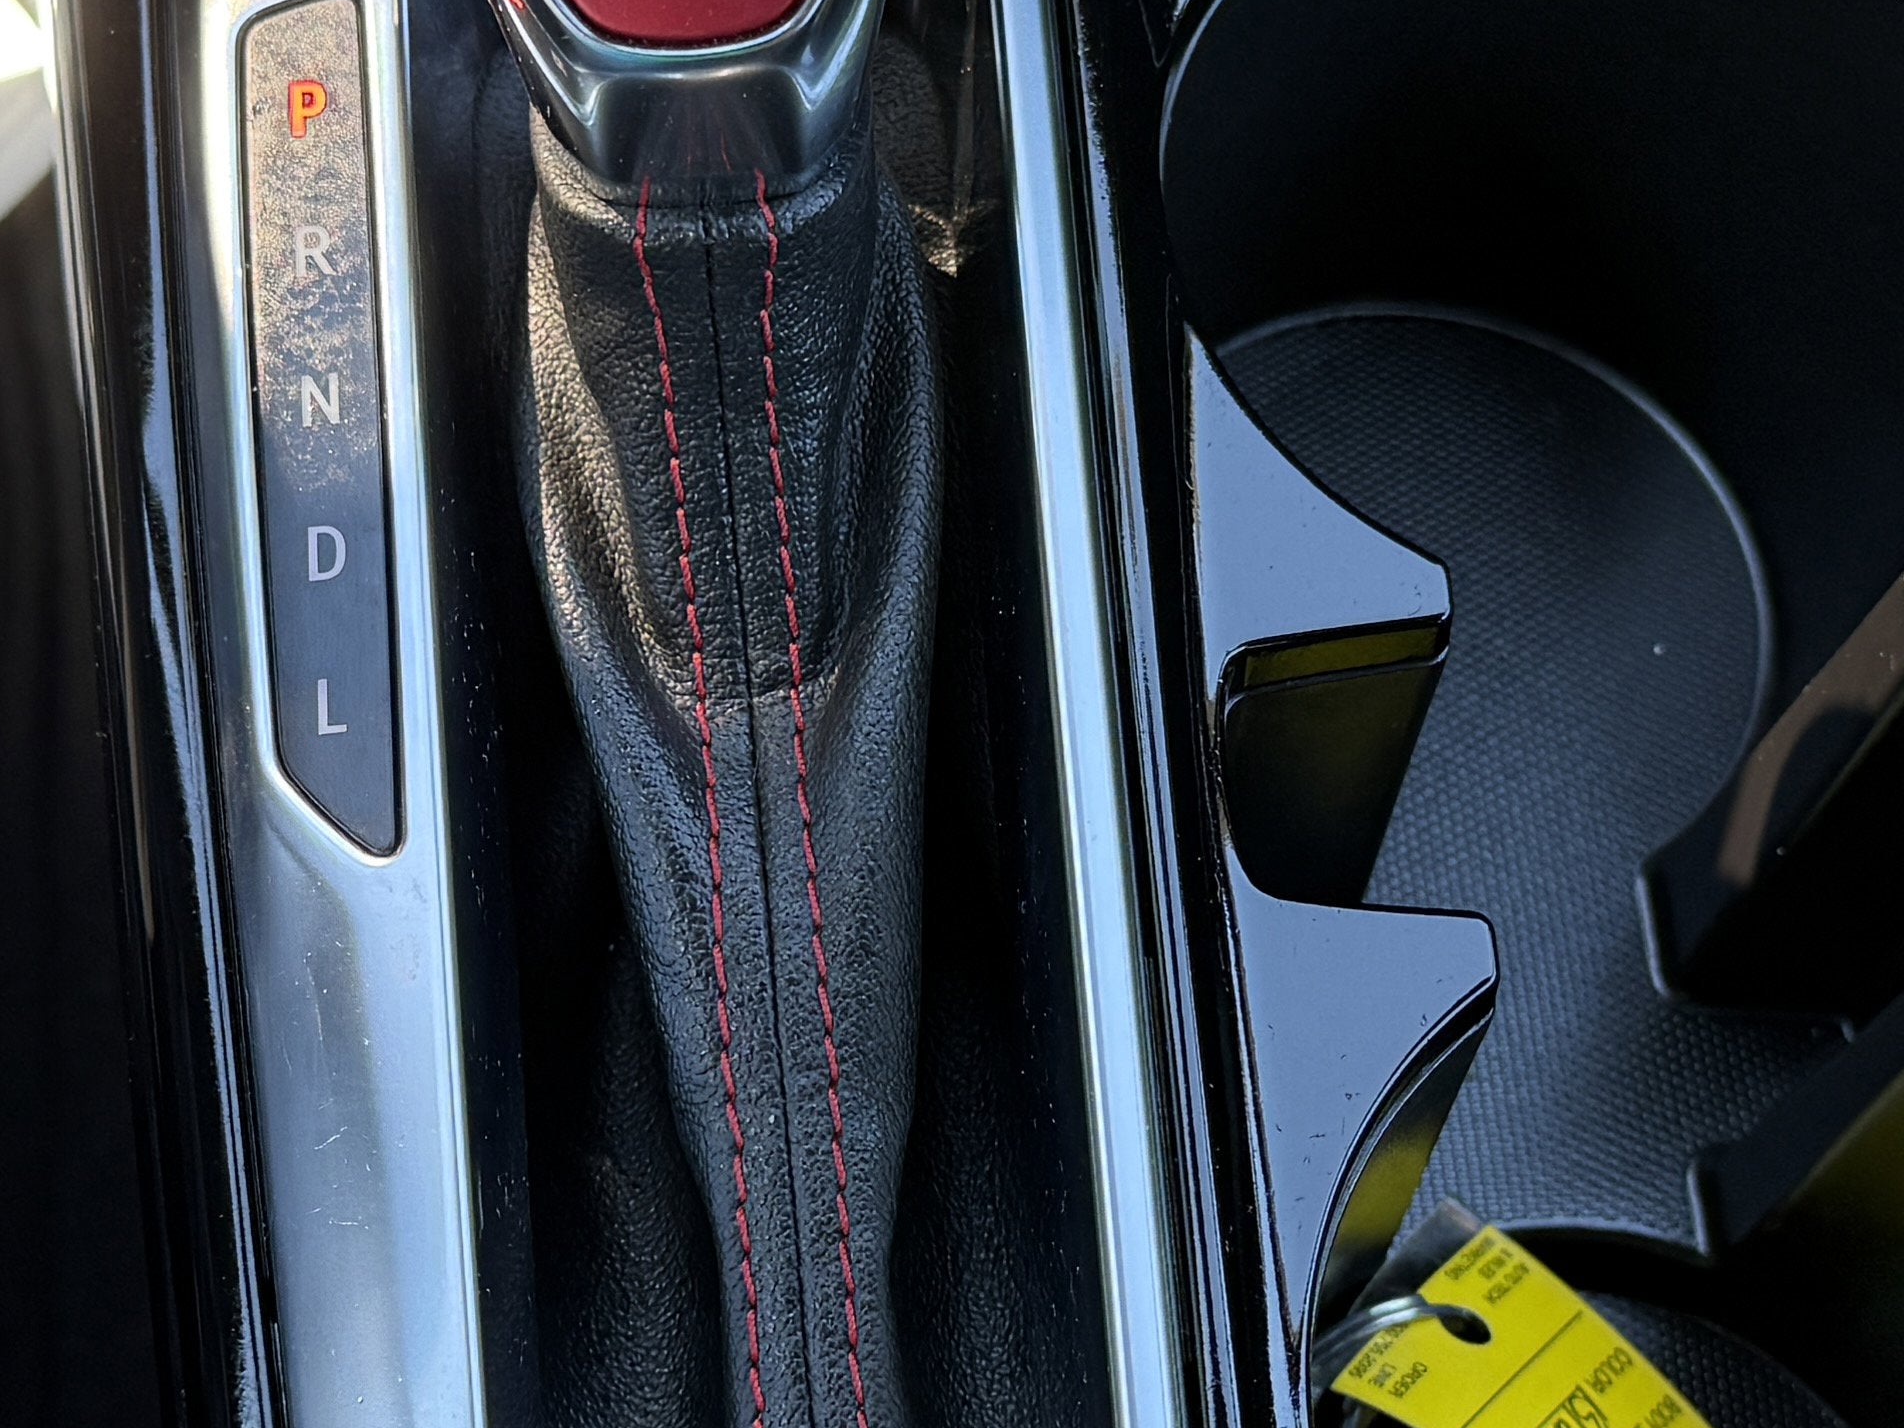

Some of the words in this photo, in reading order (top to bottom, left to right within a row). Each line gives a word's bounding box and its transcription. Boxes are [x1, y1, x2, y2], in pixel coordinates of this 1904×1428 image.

[286, 80, 328, 139] P
[293, 224, 331, 277] R
[300, 373, 340, 428] N
[307, 524, 347, 582] D
[316, 678, 348, 736] L
[1586, 1347, 1634, 1394] COLOR
